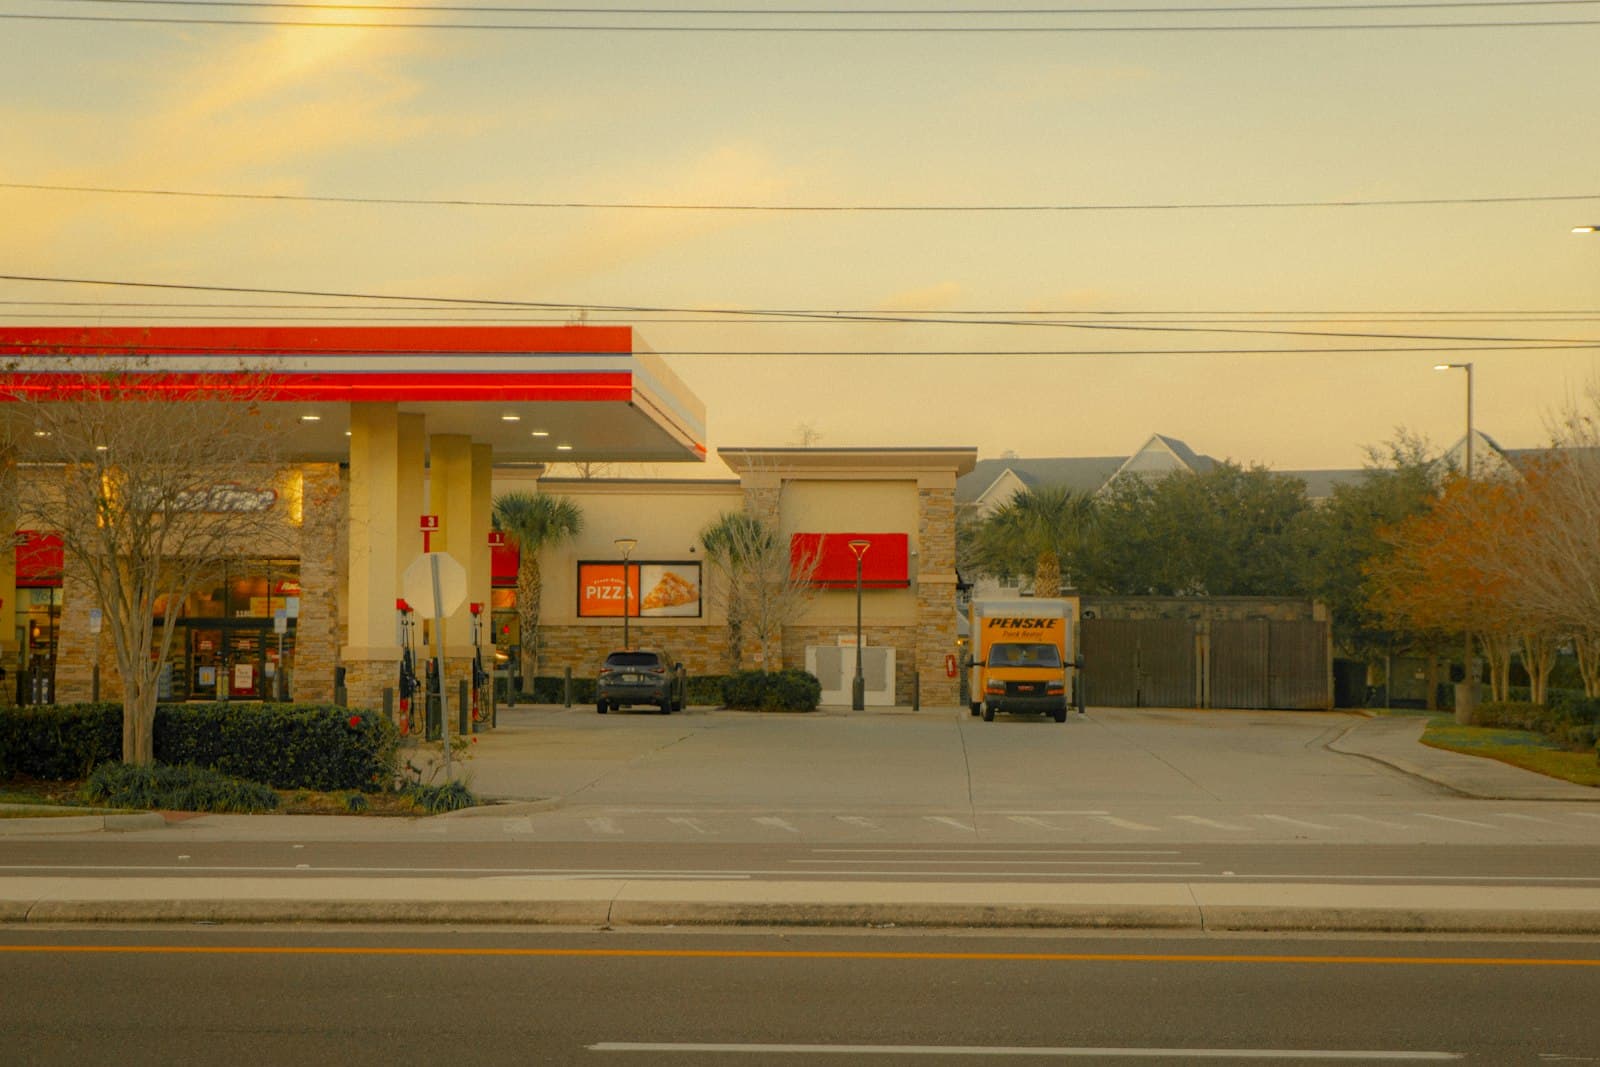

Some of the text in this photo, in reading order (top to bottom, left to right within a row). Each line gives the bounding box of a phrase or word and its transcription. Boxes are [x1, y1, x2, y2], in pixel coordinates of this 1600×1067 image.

[428, 517, 435, 527] 3
[496, 534, 500, 543] 1
[586, 586, 634, 600] PIZZA
[989, 618, 1058, 628] PENSKE
